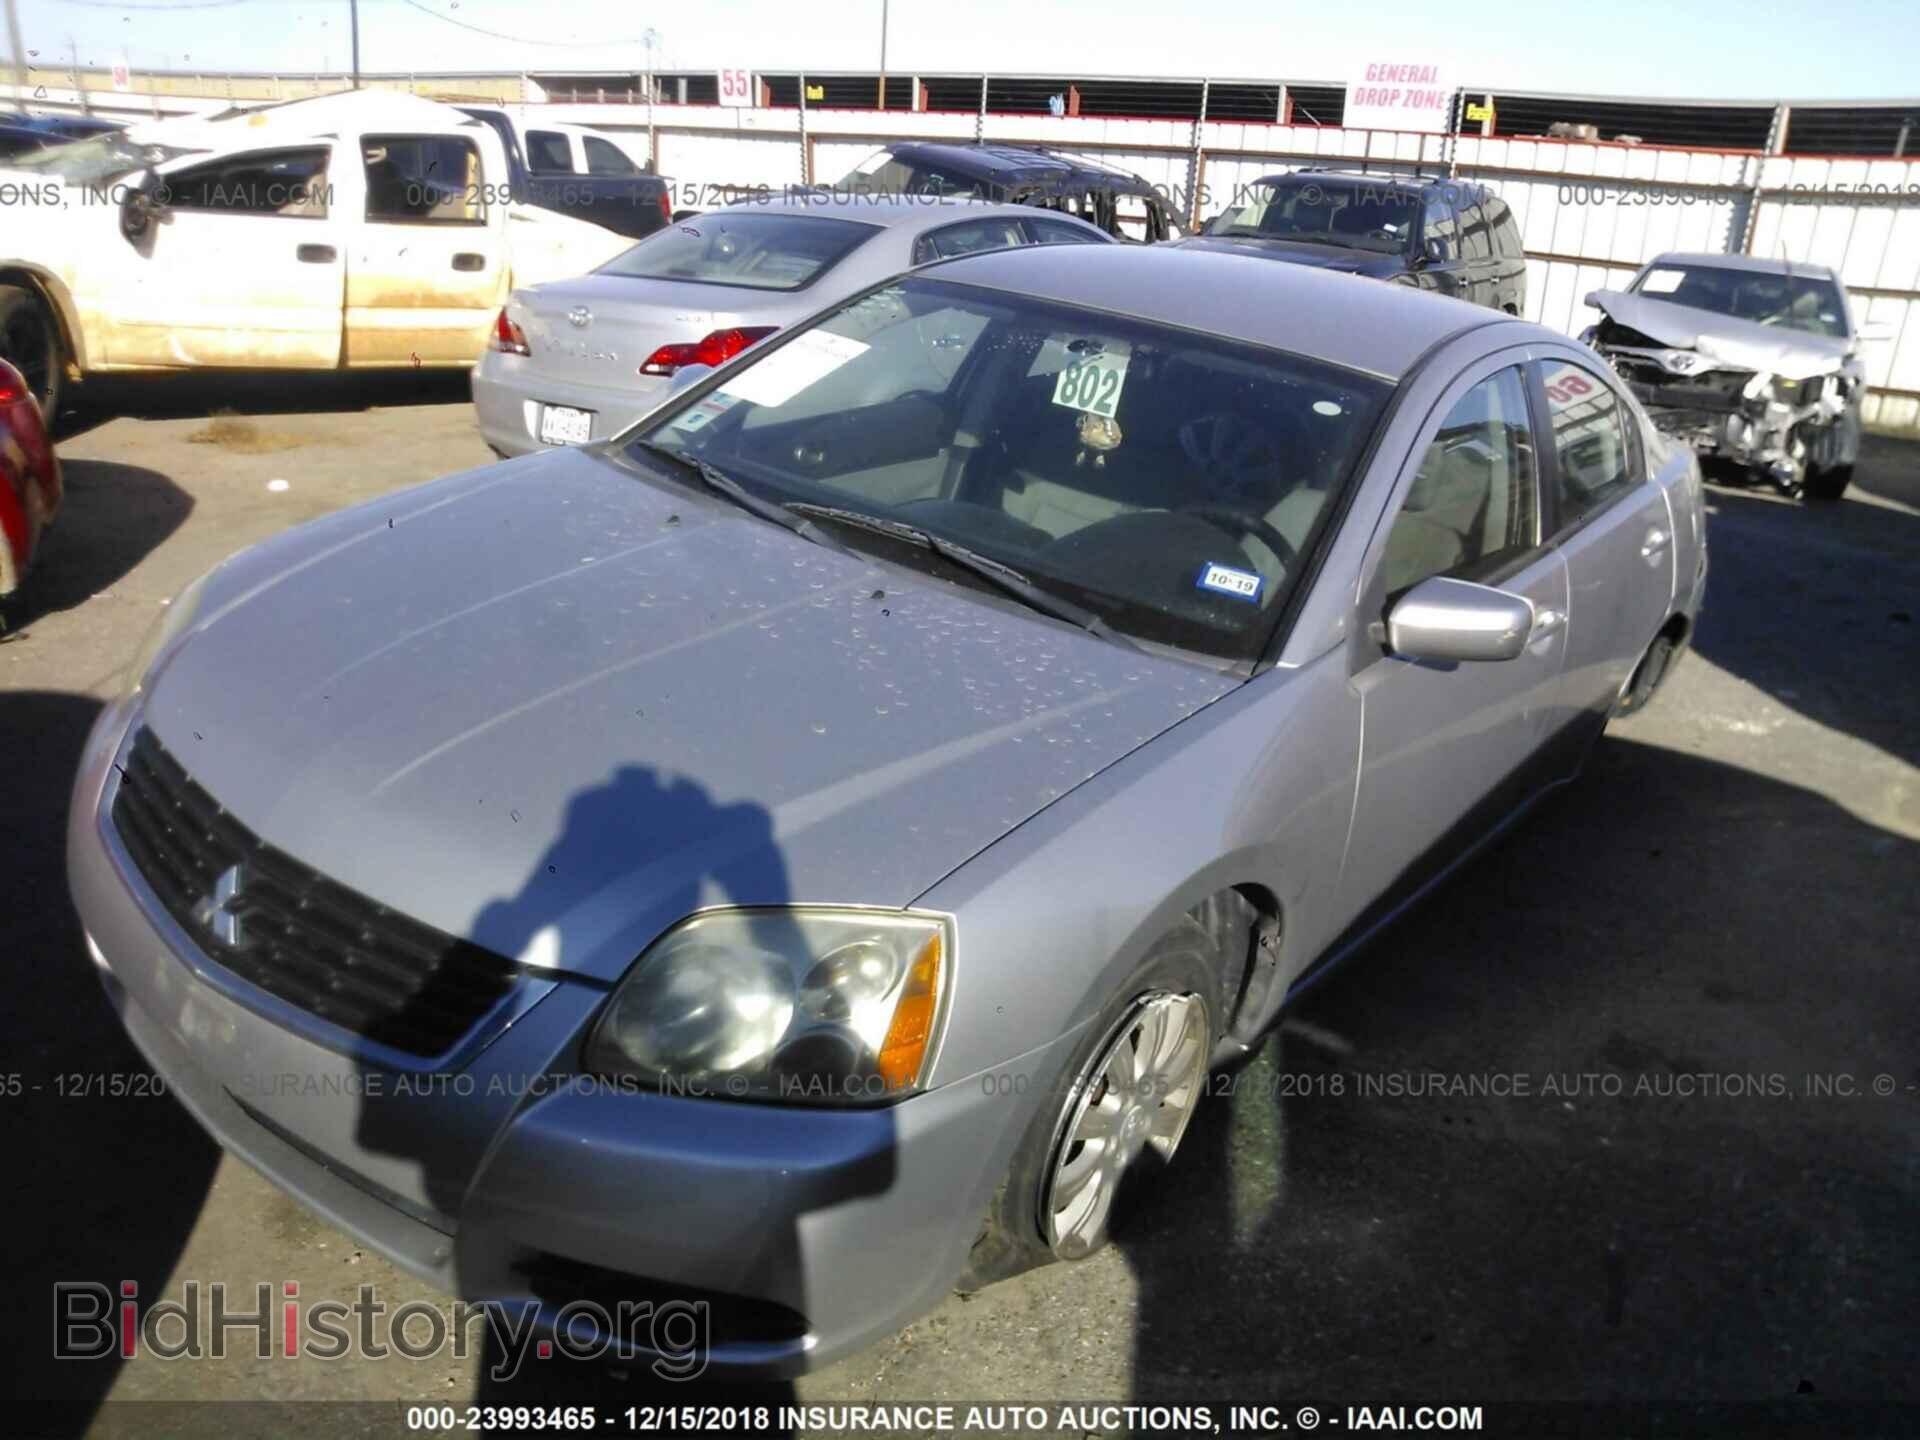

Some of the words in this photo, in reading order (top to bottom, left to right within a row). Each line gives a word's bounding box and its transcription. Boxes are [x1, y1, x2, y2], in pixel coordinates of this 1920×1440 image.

[723, 69, 747, 96] 55
[1365, 64, 1439, 84] GENERAL
[1353, 87, 1400, 107] DROP
[1402, 90, 1446, 109] ZONE
[1061, 361, 1119, 414] 802
